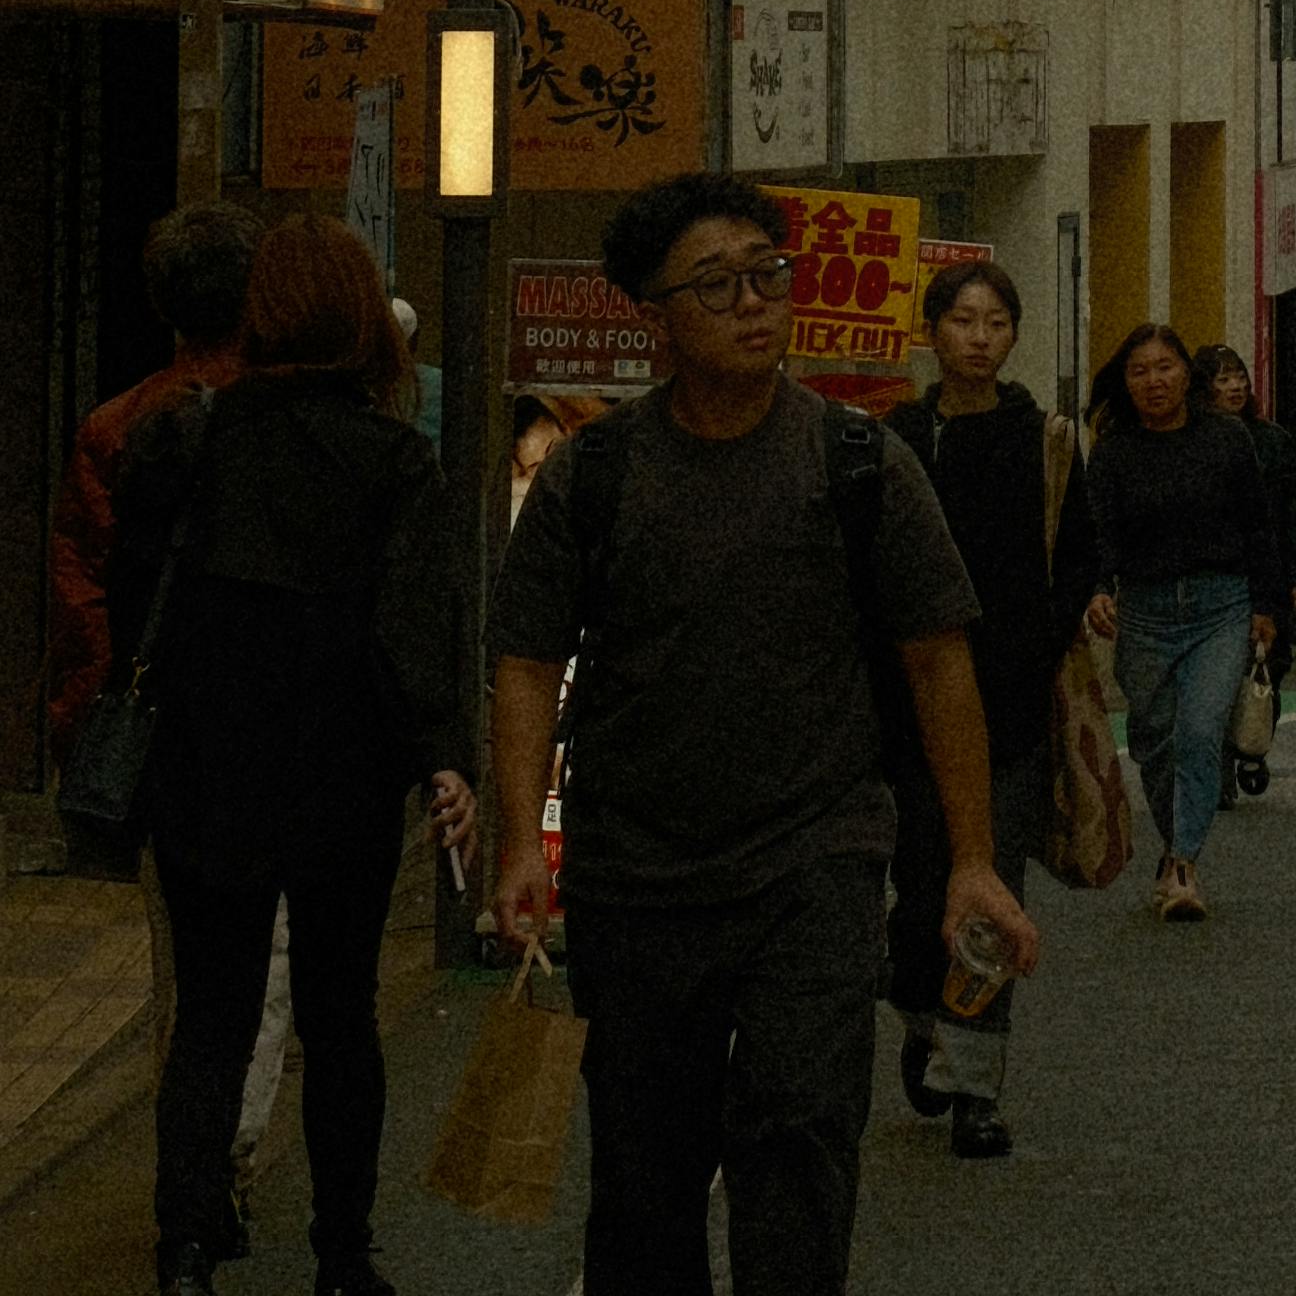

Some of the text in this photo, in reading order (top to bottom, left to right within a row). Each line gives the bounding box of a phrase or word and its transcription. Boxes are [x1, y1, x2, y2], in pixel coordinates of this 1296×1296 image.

[516, 275, 642, 320] MASSA
[526, 328, 582, 349] BODY
[586, 329, 600, 349] &
